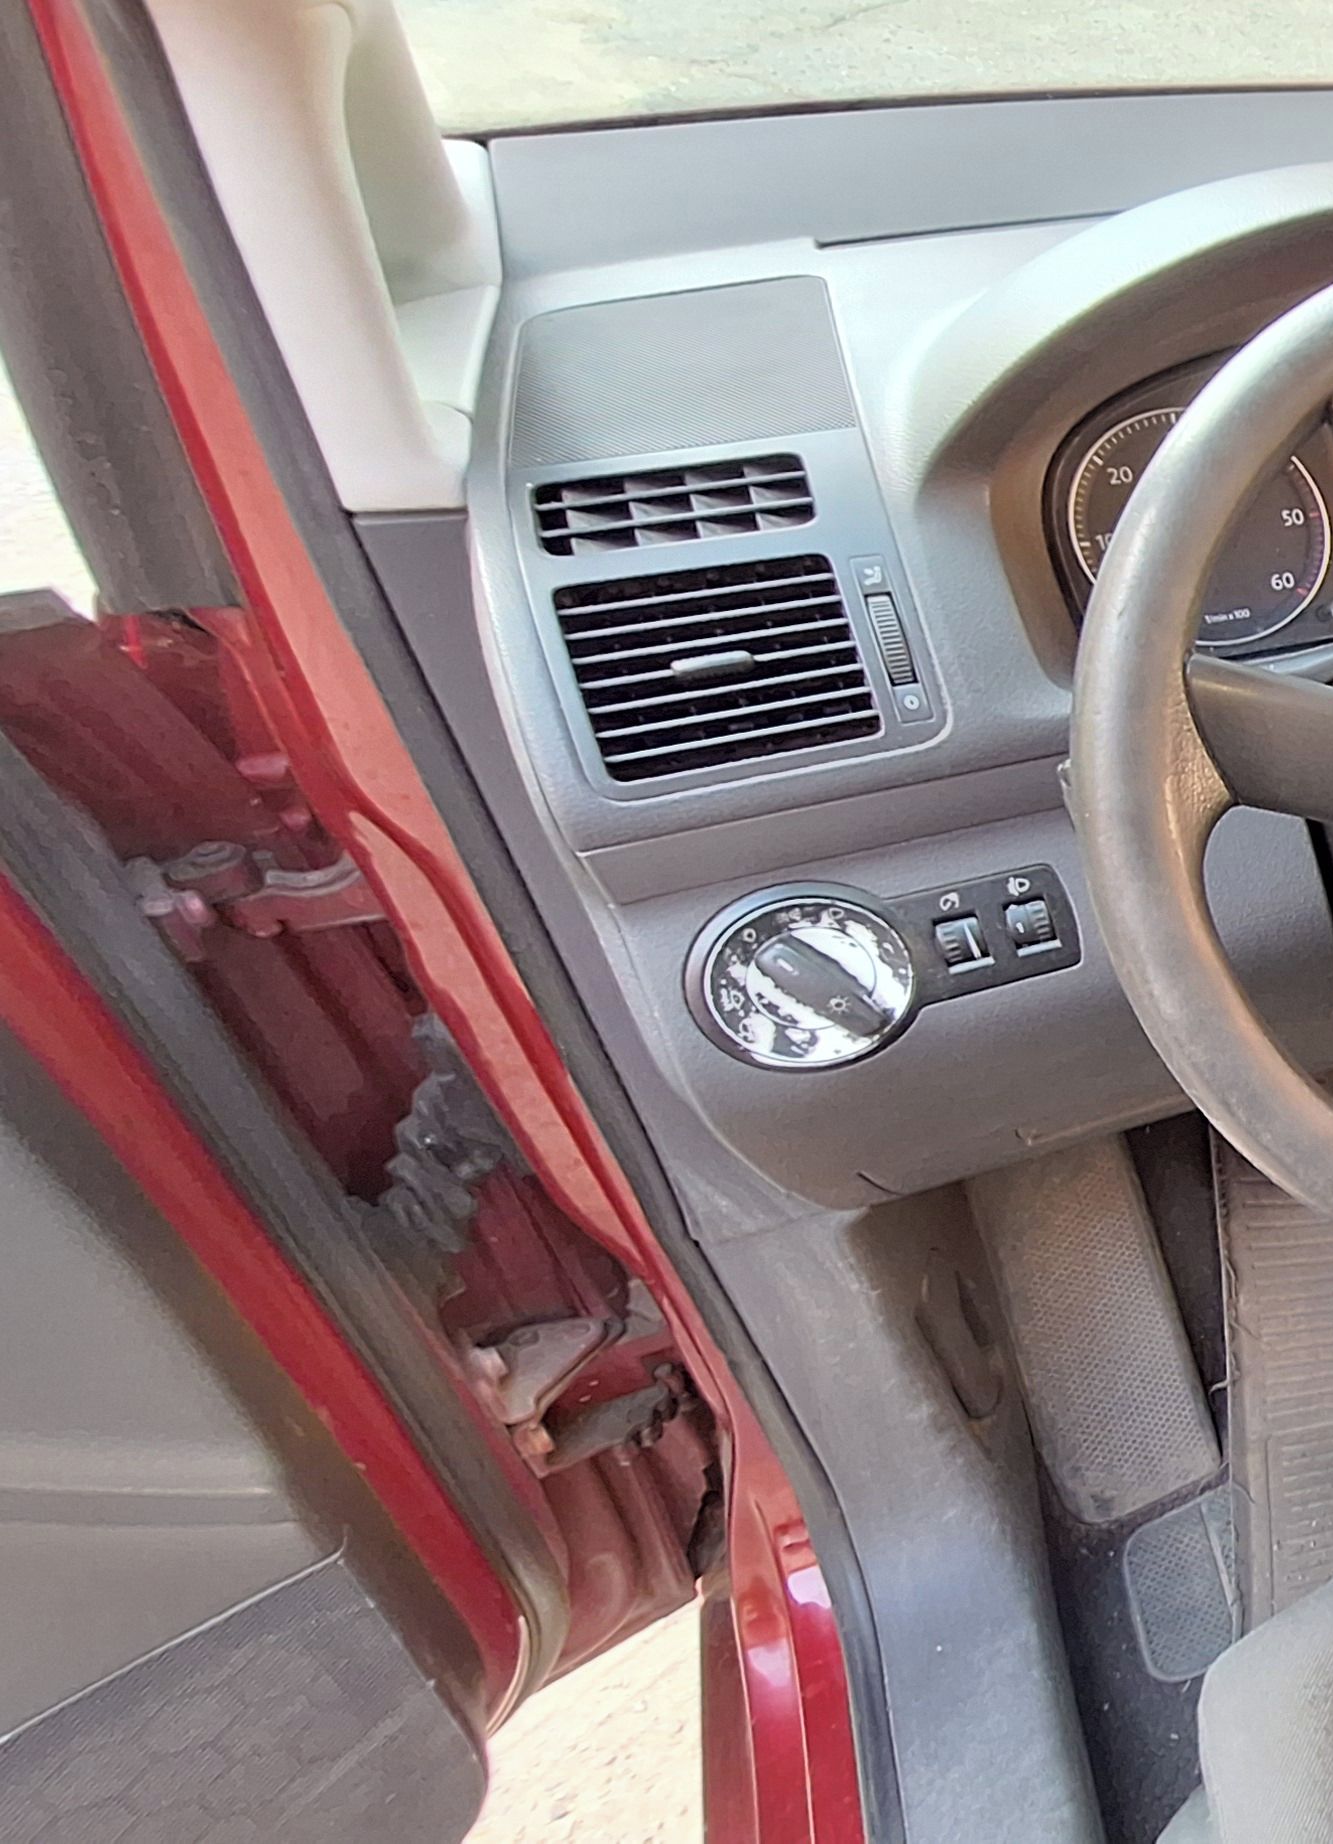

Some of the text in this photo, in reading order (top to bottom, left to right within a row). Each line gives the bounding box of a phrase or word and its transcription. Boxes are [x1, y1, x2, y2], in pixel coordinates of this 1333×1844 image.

[1106, 466, 1133, 485] 20
[1281, 508, 1304, 527] 50
[1271, 571, 1295, 591] 60
[1233, 608, 1251, 619] 100
